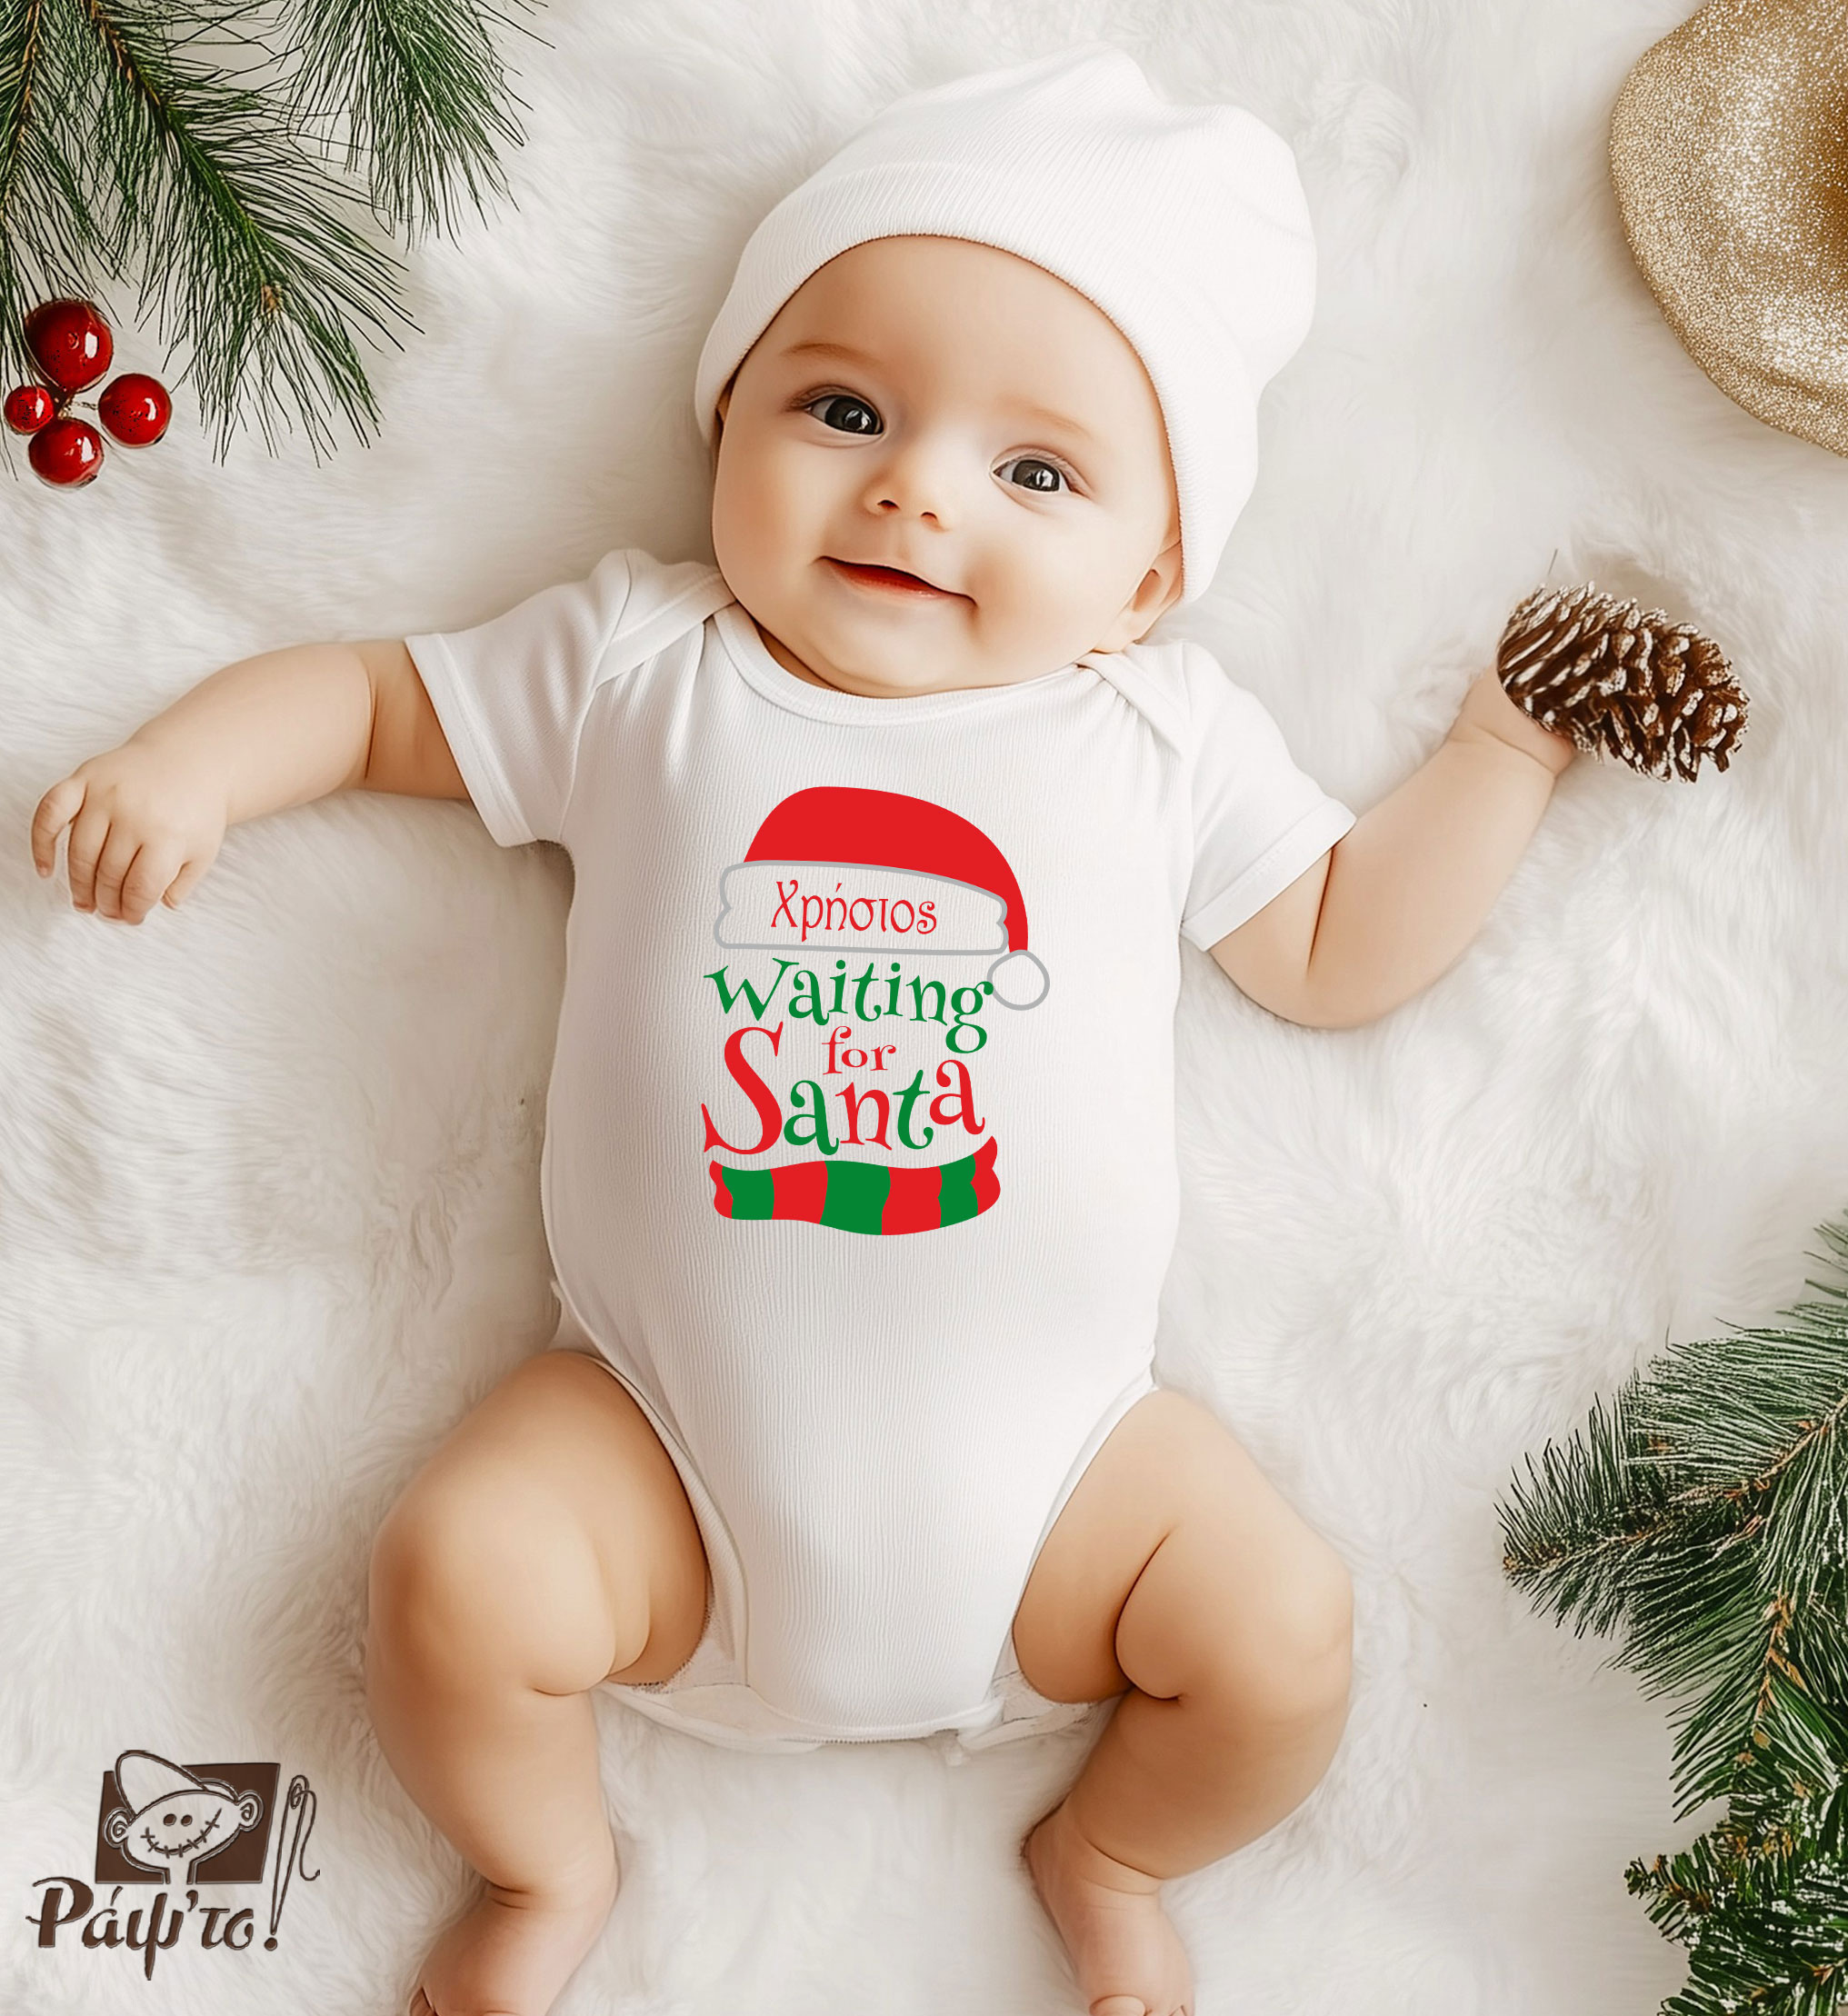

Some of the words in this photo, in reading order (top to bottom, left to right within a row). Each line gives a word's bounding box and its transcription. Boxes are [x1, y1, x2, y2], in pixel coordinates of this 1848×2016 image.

[703, 957, 994, 1054] Waiting
[821, 1025, 897, 1075] for
[700, 1021, 986, 1156] Santa
